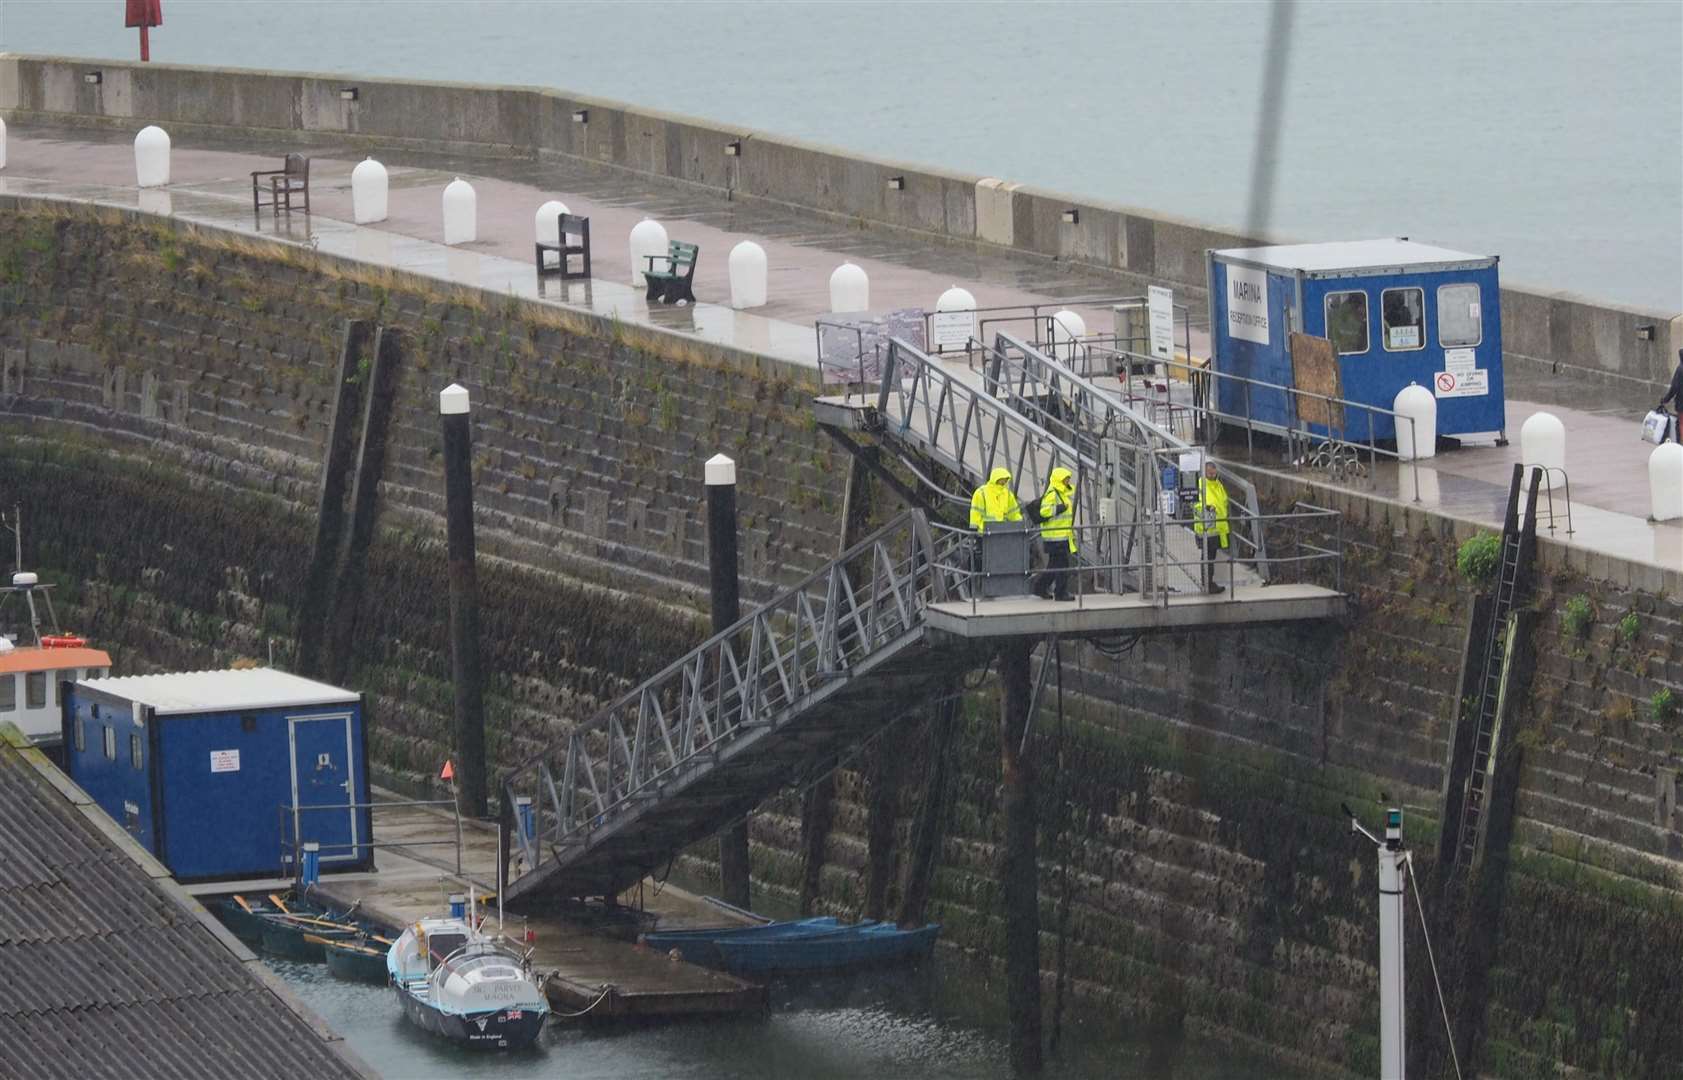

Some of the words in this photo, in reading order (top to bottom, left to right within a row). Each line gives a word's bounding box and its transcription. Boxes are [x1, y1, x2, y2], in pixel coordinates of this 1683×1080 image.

[1233, 280, 1261, 304] MARINA
[1230, 310, 1252, 325] RECEPTION
[1252, 313, 1267, 328] OFFICE
